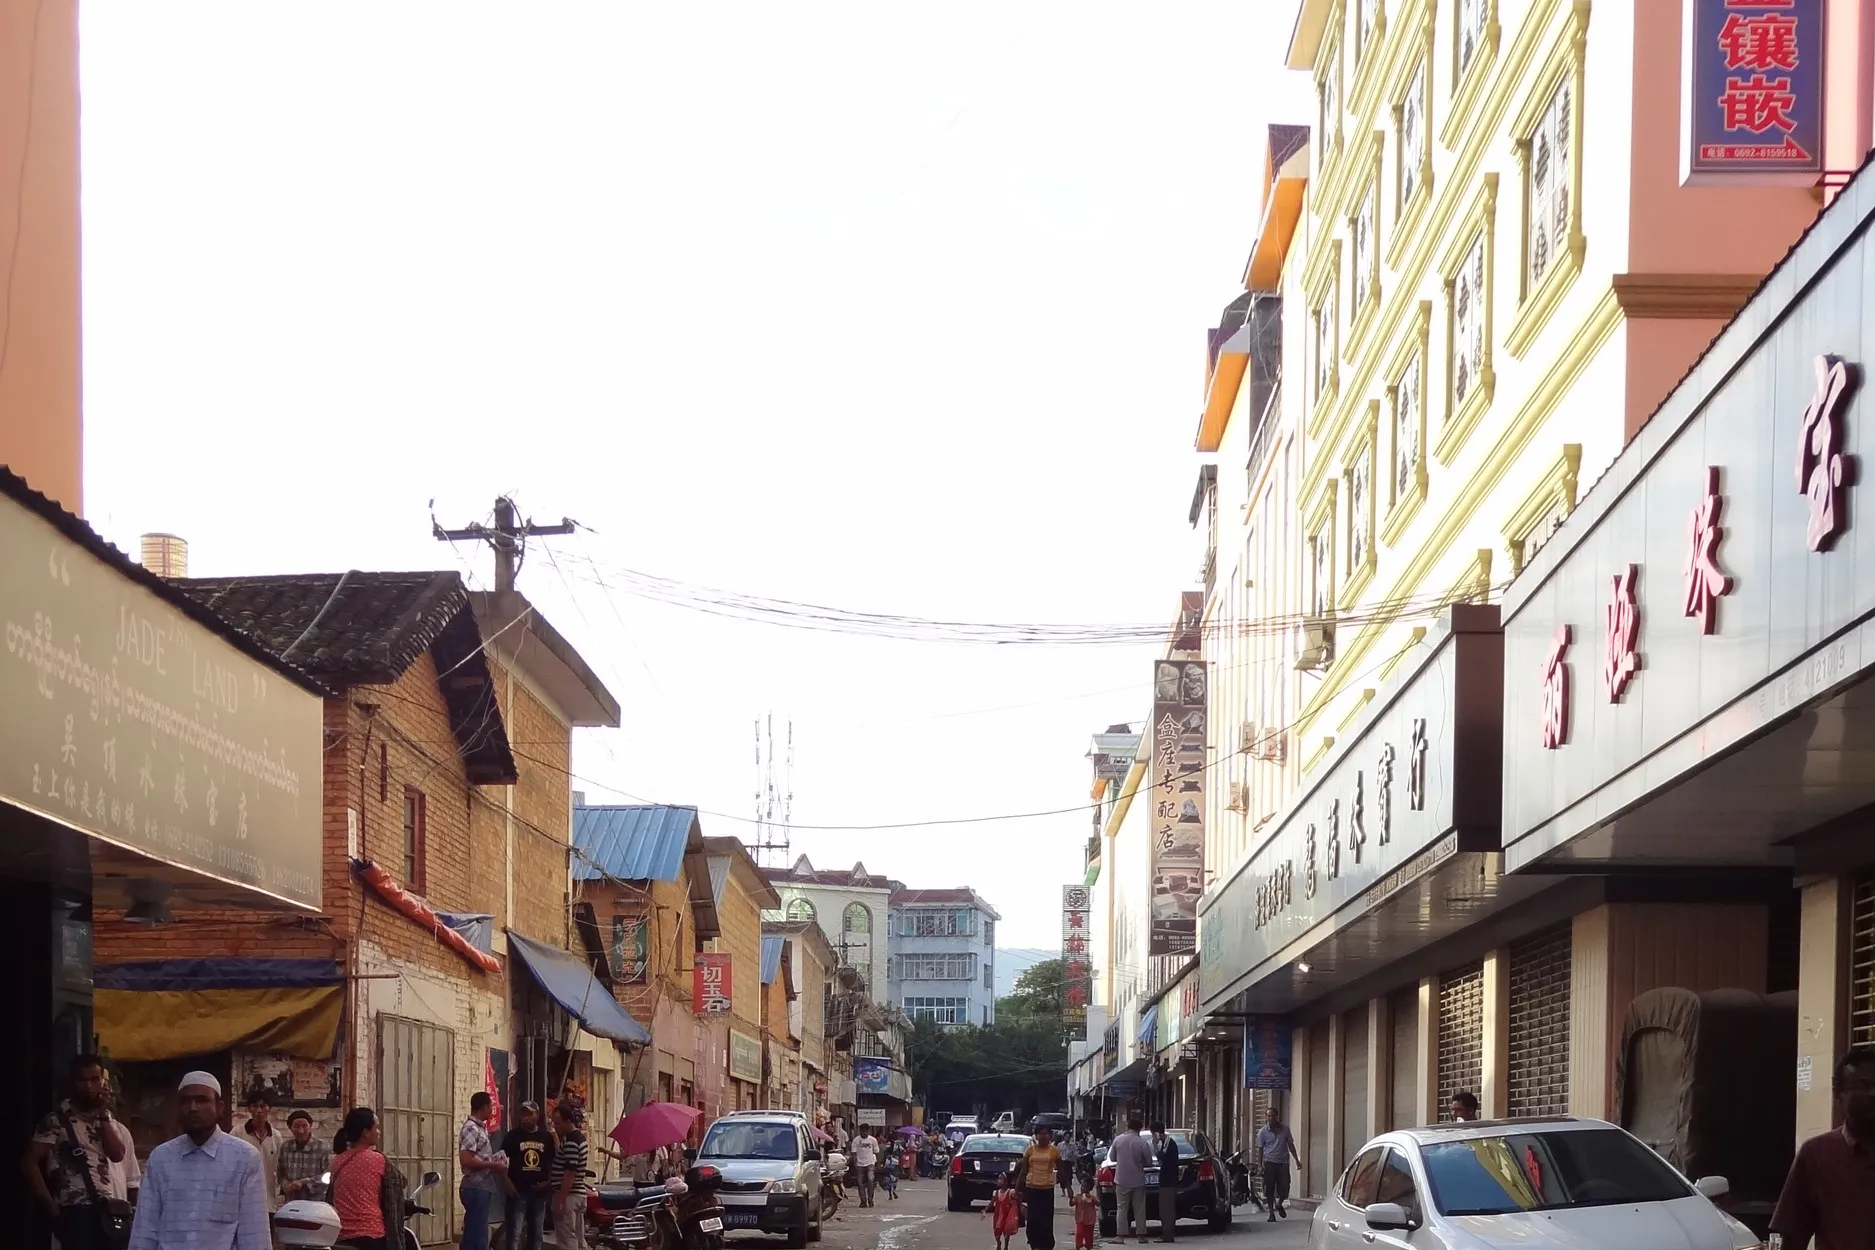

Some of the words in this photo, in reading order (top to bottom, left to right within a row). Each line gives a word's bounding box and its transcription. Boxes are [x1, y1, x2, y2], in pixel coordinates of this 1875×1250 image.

[1717, 0, 1800, 134] 镶嵌
[116, 605, 166, 677] JADE
[192, 650, 238, 715] LAND
[1156, 712, 1181, 850] 盒座专配店
[701, 966, 724, 1012] 切玉石
